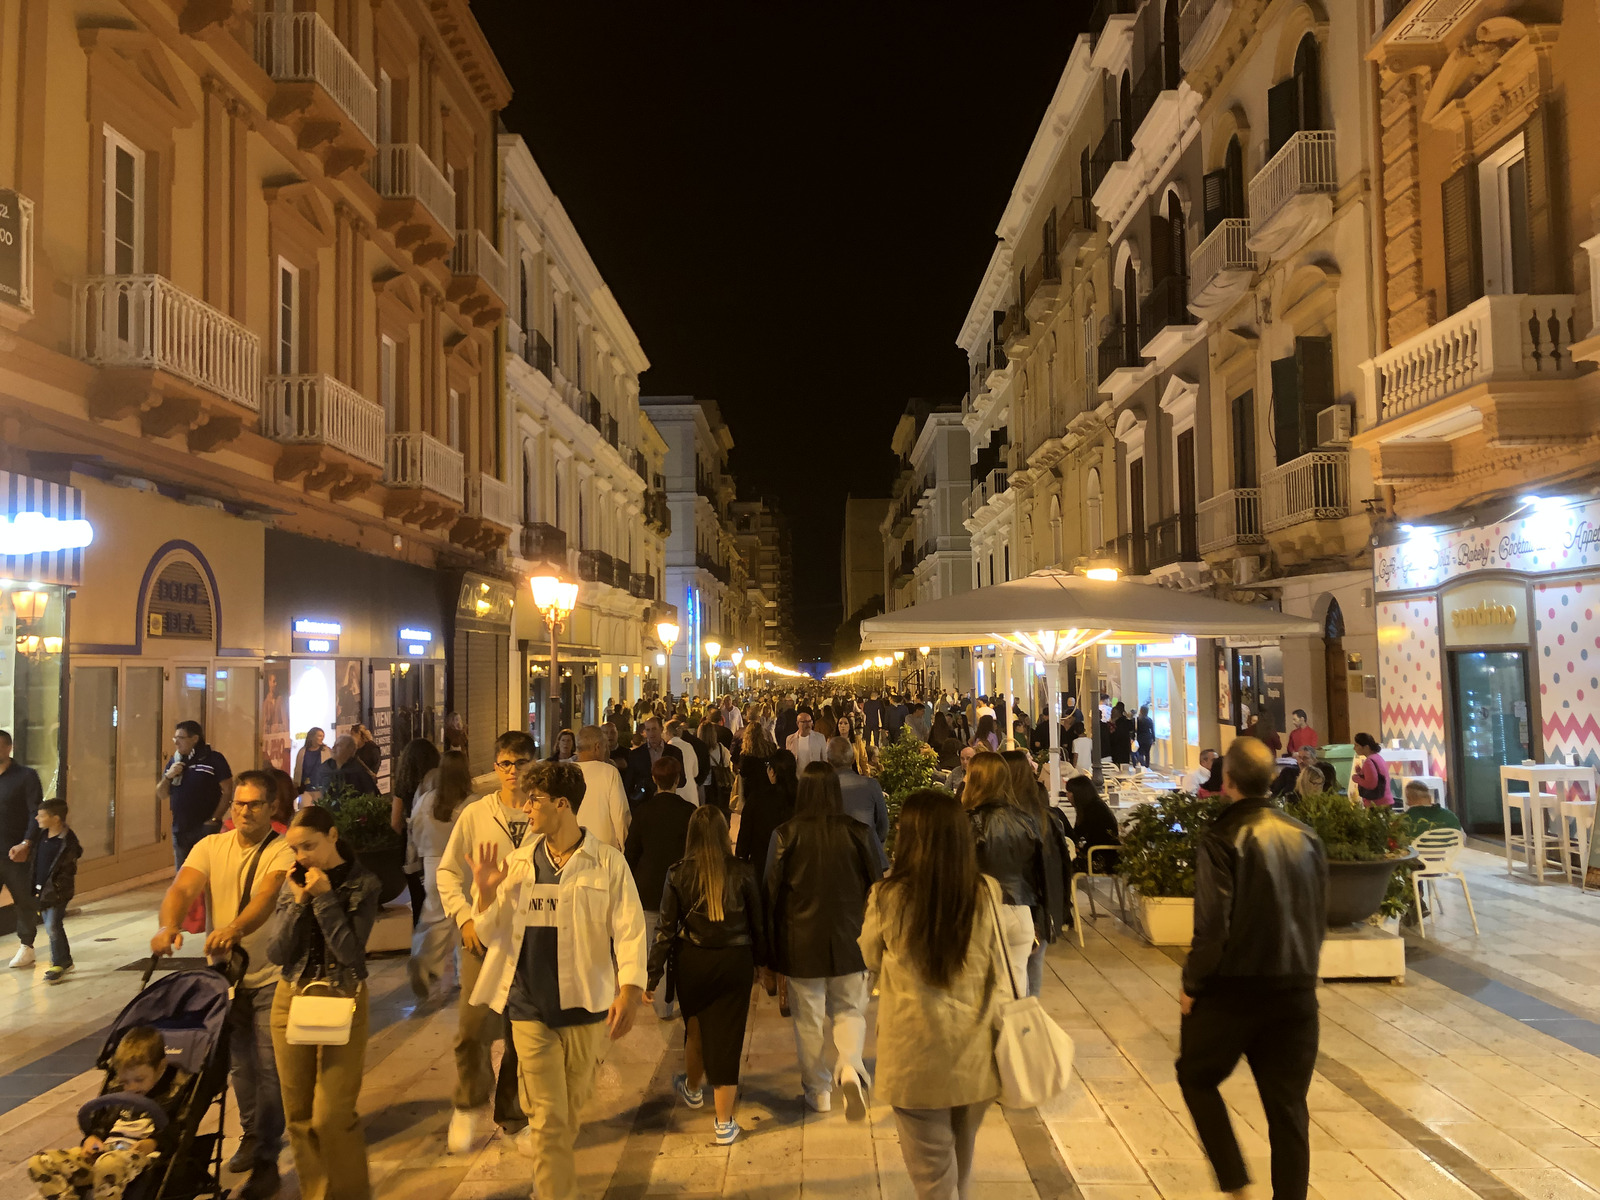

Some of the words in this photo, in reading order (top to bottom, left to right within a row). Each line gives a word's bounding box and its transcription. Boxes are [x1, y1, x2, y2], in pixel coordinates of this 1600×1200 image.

[1458, 543, 1489, 567] Bakery
[1451, 598, 1517, 629] sandrino
[528, 897, 544, 911] NE
